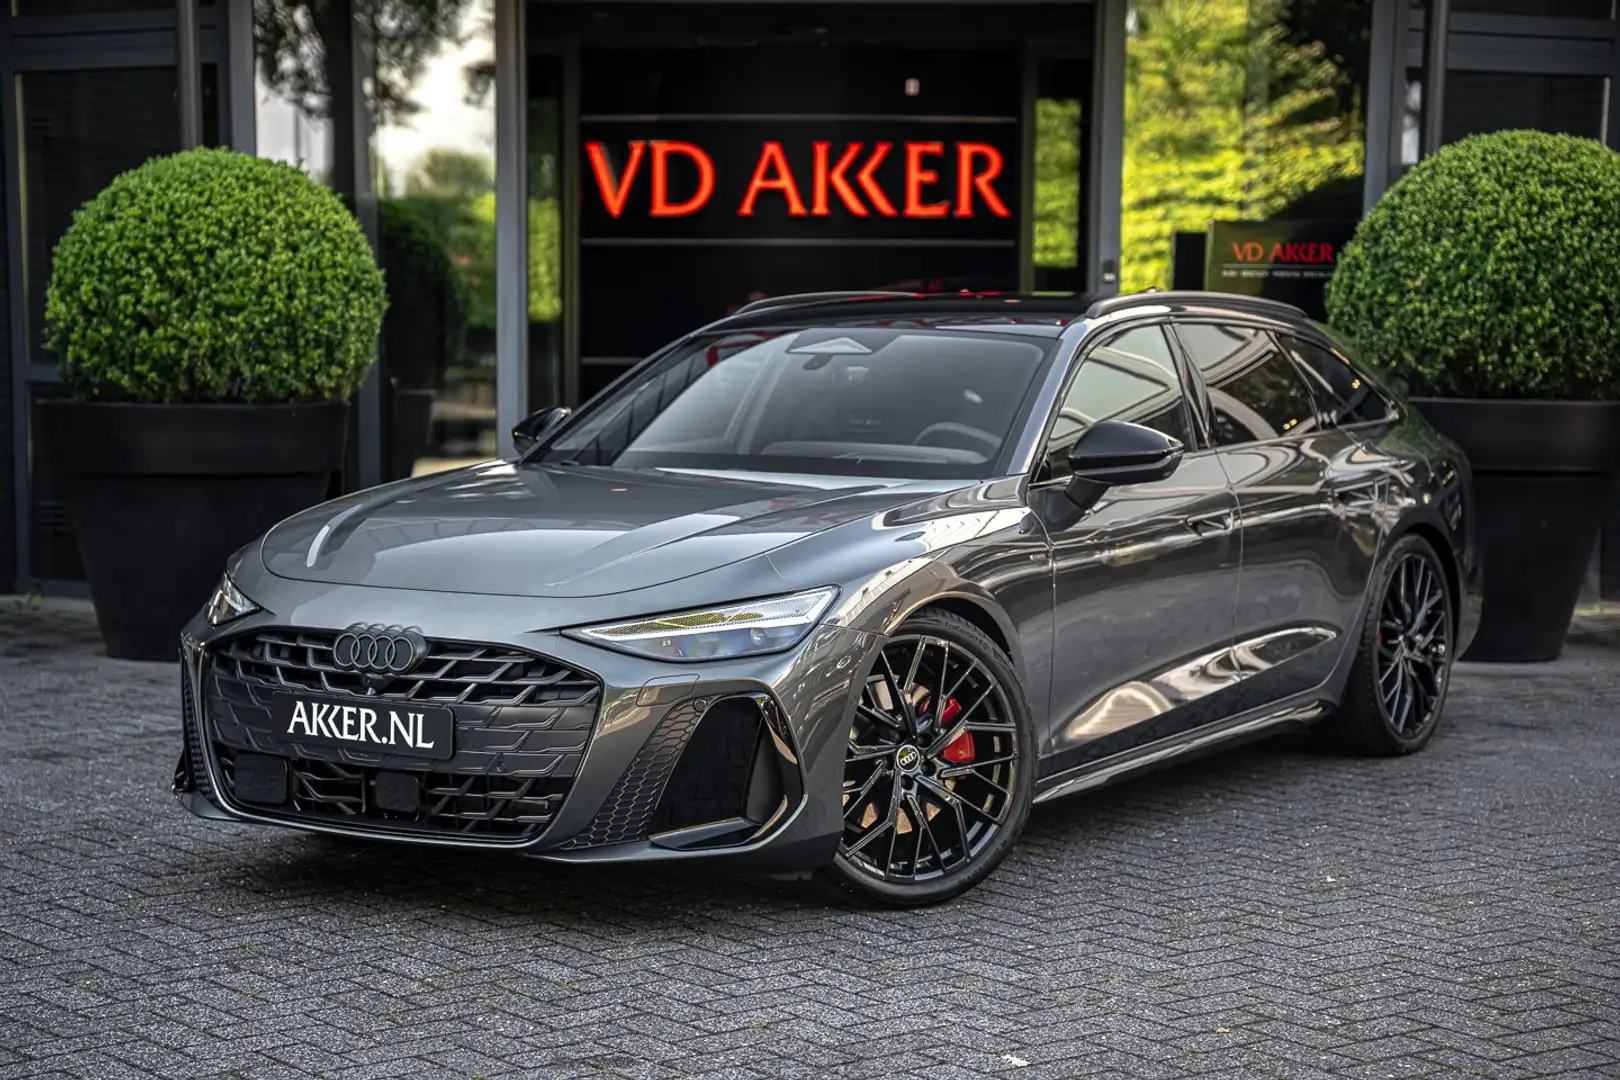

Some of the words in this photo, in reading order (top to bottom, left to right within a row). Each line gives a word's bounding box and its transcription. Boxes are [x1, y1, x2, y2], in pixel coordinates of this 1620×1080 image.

[585, 139, 716, 218] VD
[737, 140, 1011, 217] AKKER
[1231, 241, 1264, 262] VD
[1268, 241, 1334, 263] AKKER
[286, 700, 435, 749] AKKER.NL
